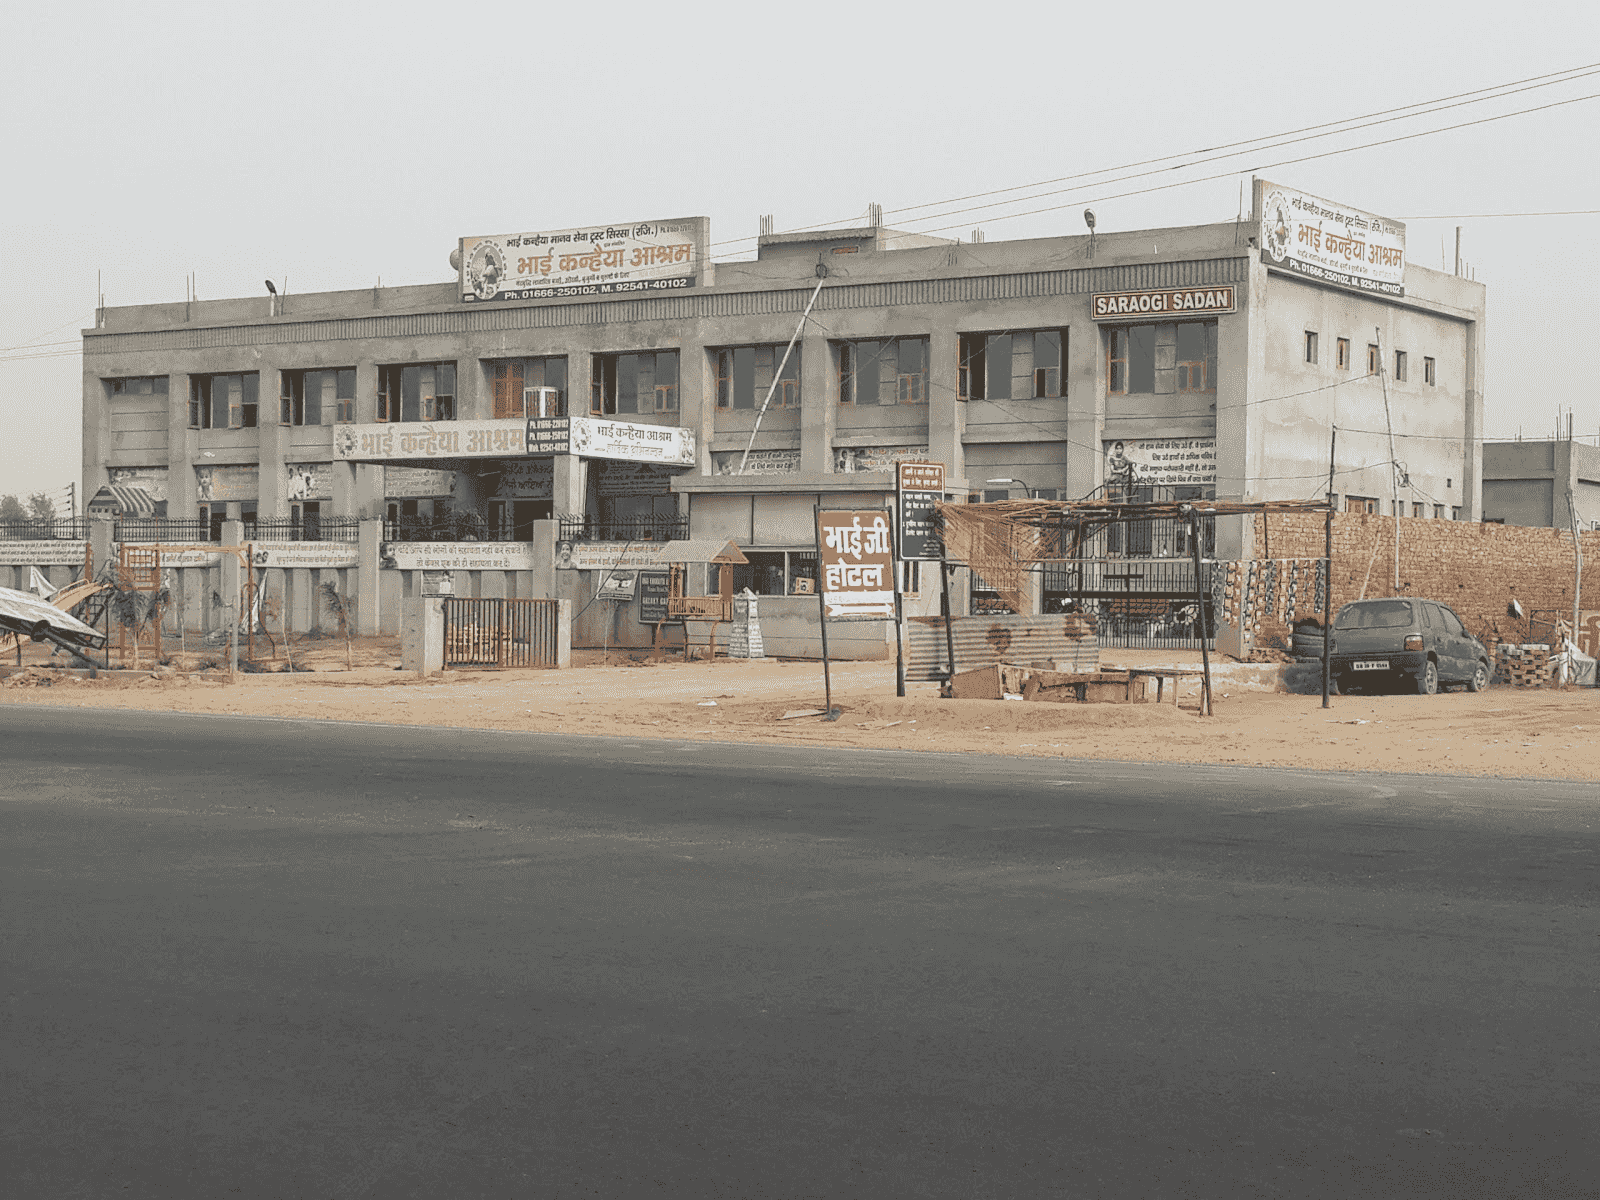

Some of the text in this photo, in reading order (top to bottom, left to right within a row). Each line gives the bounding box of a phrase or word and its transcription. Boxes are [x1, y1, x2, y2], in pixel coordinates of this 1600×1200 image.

[507, 235, 521, 248] भाई
[523, 234, 549, 248] कन्हैया
[550, 232, 572, 244] मानव
[574, 230, 588, 242] सेवा
[589, 230, 605, 245] ट्रस्ट
[606, 226, 630, 240] सिरसा
[1298, 220, 1322, 253] भाई
[1325, 228, 1366, 261] कन्हैया
[1368, 244, 1403, 269] आश्रम
[517, 247, 554, 276] भाई
[558, 242, 626, 272] कन्हैया
[630, 242, 693, 266] आश्रम
[504, 278, 687, 300] Ph. 01666-250102, M. 92541-40102
[1097, 290, 1228, 314] SARAOGI SADAN
[361, 425, 526, 457] भाई कन्हैया आश्रम
[598, 423, 673, 442] भाई कन्हैया आश्रम
[823, 516, 862, 560] भाई
[862, 516, 889, 554] जी
[826, 557, 884, 590] होटल
